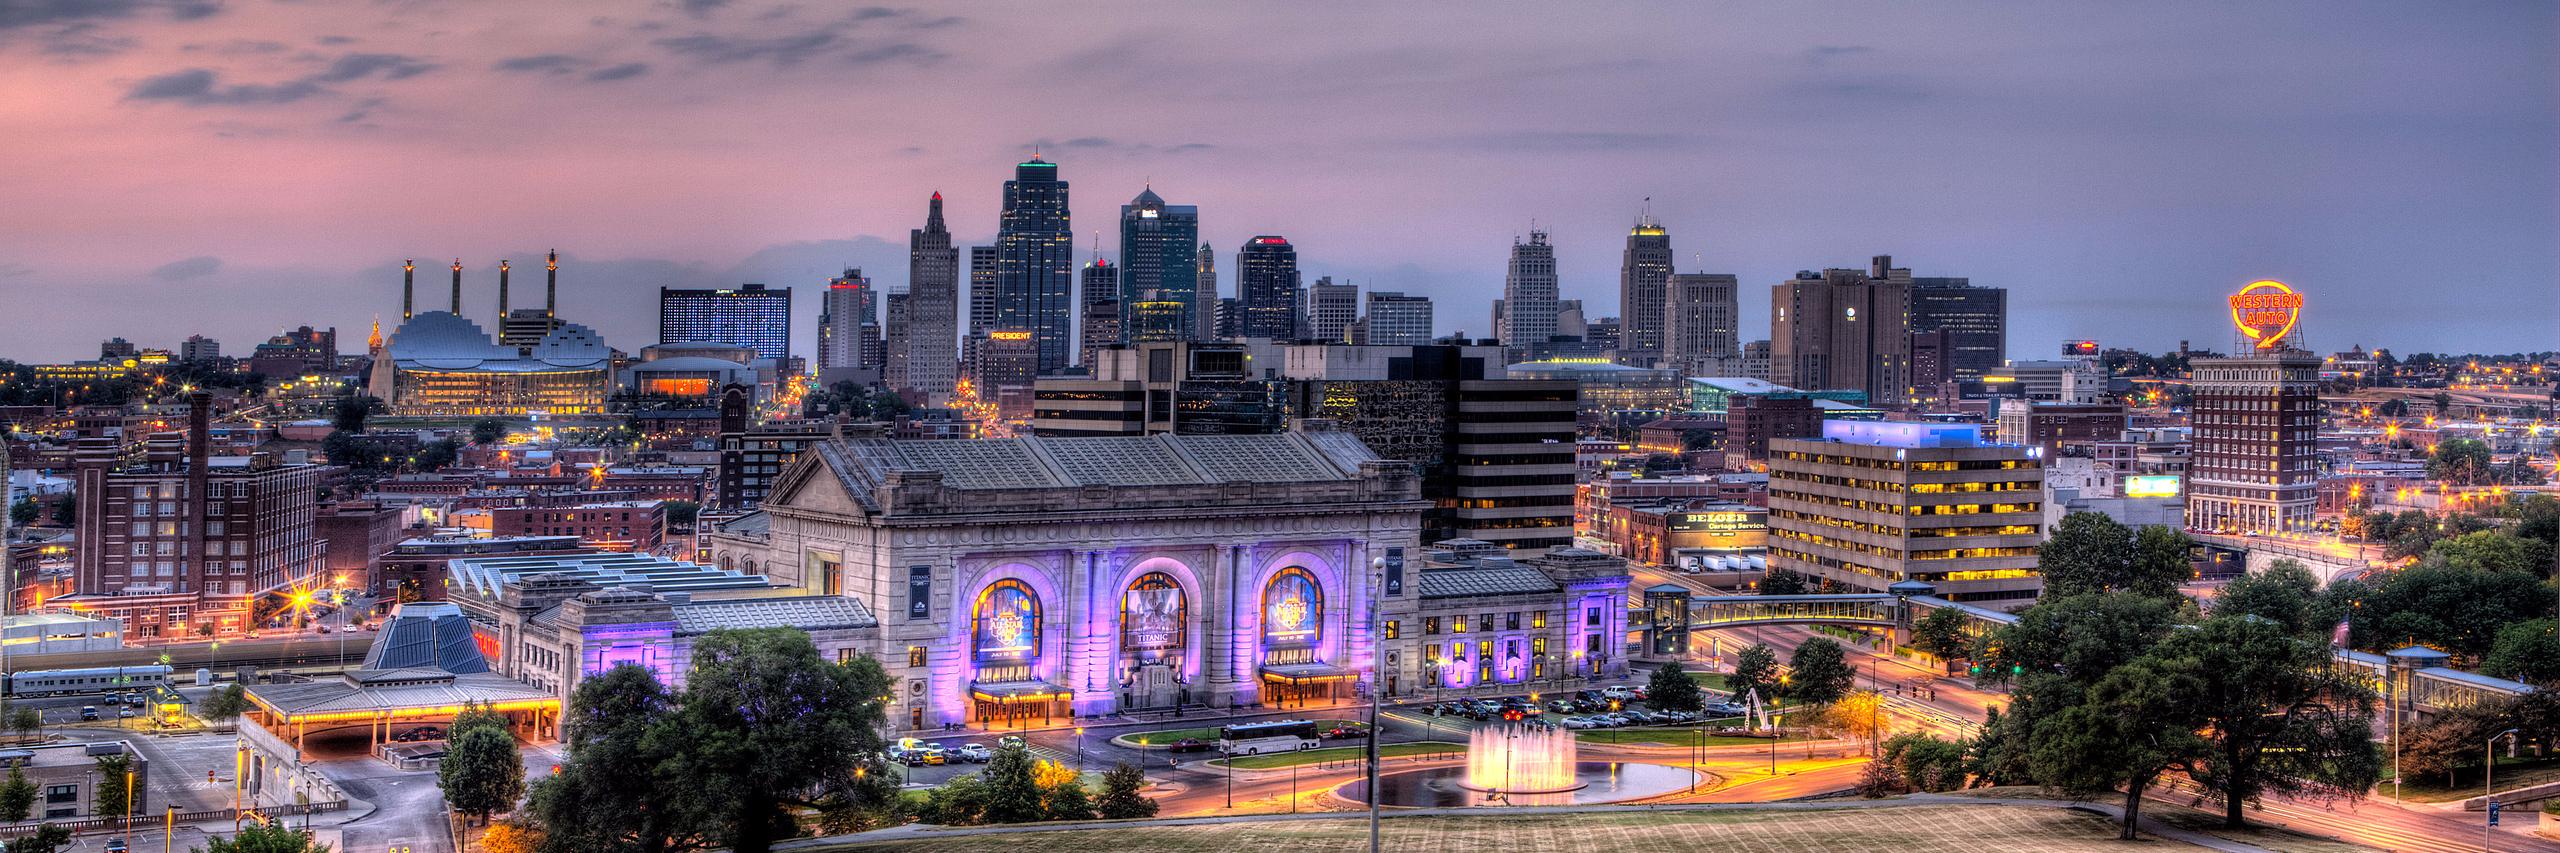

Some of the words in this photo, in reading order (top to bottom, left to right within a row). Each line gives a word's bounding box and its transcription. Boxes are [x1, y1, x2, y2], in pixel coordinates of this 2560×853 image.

[2229, 294, 2303, 308] WESTERN
[2246, 311, 2288, 325] AUTO
[991, 331, 1031, 340] PRESIDENT
[1686, 514, 1747, 522] BELGER
[1138, 633, 1168, 642] TITANIC
